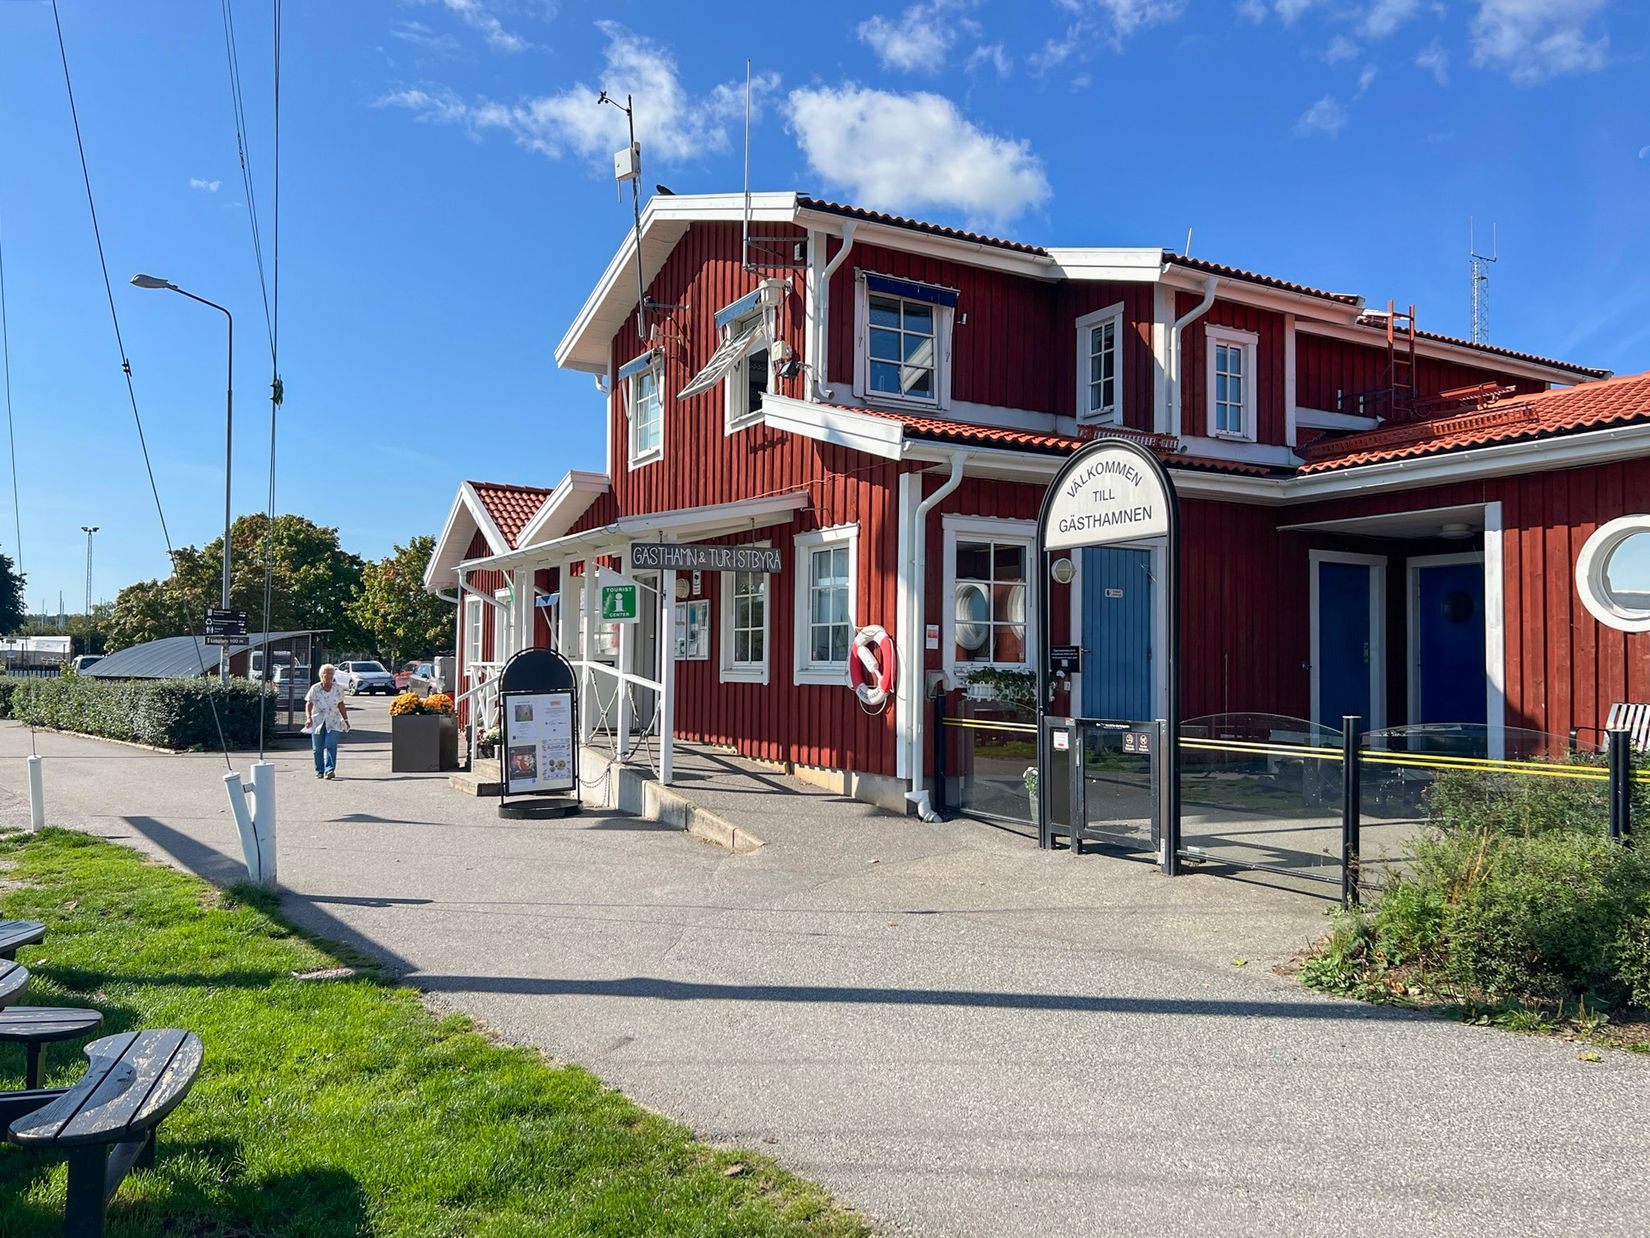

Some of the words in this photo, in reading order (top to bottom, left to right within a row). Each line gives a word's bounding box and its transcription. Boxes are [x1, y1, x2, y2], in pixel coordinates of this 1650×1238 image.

[1066, 460, 1143, 498] VÄLKOMMEN
[1092, 488, 1116, 502] TILL
[1058, 505, 1152, 533] GÄSTHAMNEN
[632, 546, 698, 566] GÄSTHAMN
[699, 552, 707, 564] &
[708, 548, 782, 569] TURISTBYRÅ
